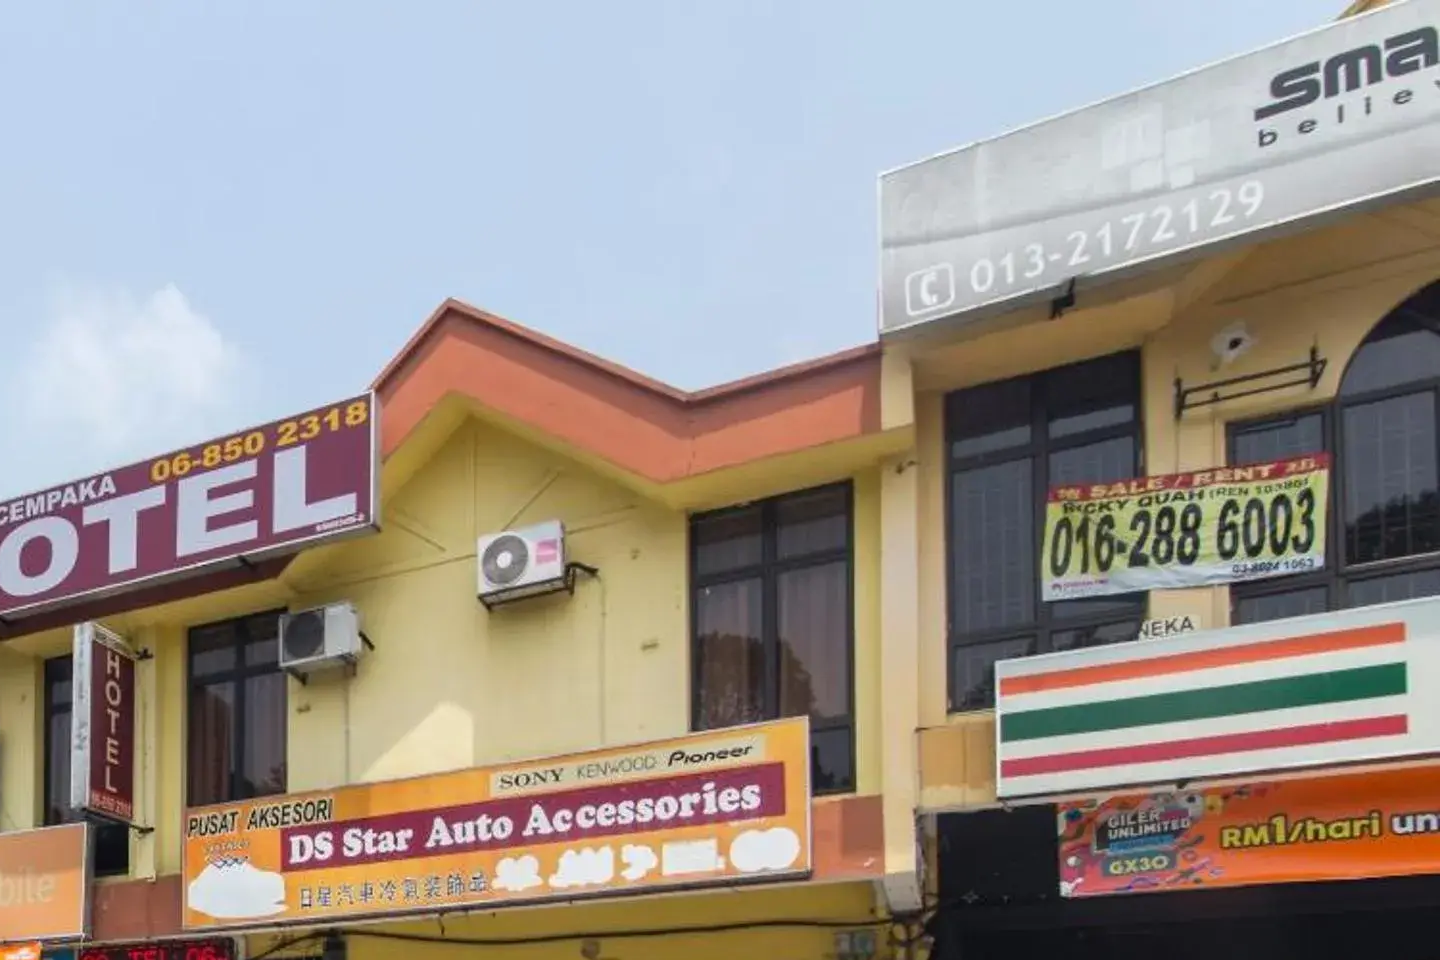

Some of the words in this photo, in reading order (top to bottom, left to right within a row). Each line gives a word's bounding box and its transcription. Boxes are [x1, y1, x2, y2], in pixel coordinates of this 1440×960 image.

[971, 180, 1264, 293] 013-2172129
[151, 432, 265, 483] 06-850
[277, 401, 368, 447] 2318
[1091, 479, 1164, 498] SALE
[1050, 502, 1203, 578] 016-288
[1216, 488, 1315, 560] 6003
[104, 650, 122, 794] HOTEL
[500, 767, 564, 788] SONY
[576, 754, 657, 779] KENWOOD
[667, 744, 753, 767] Pioneer
[187, 811, 238, 837] PUSAT
[247, 799, 333, 830] AKSESORI
[289, 831, 334, 864] DS
[342, 827, 413, 858] Star
[425, 815, 513, 848] Auto
[522, 781, 761, 837] Accessories
[1107, 818, 1191, 839] UNLIMITED
[1222, 813, 1381, 848] RM1/hari
